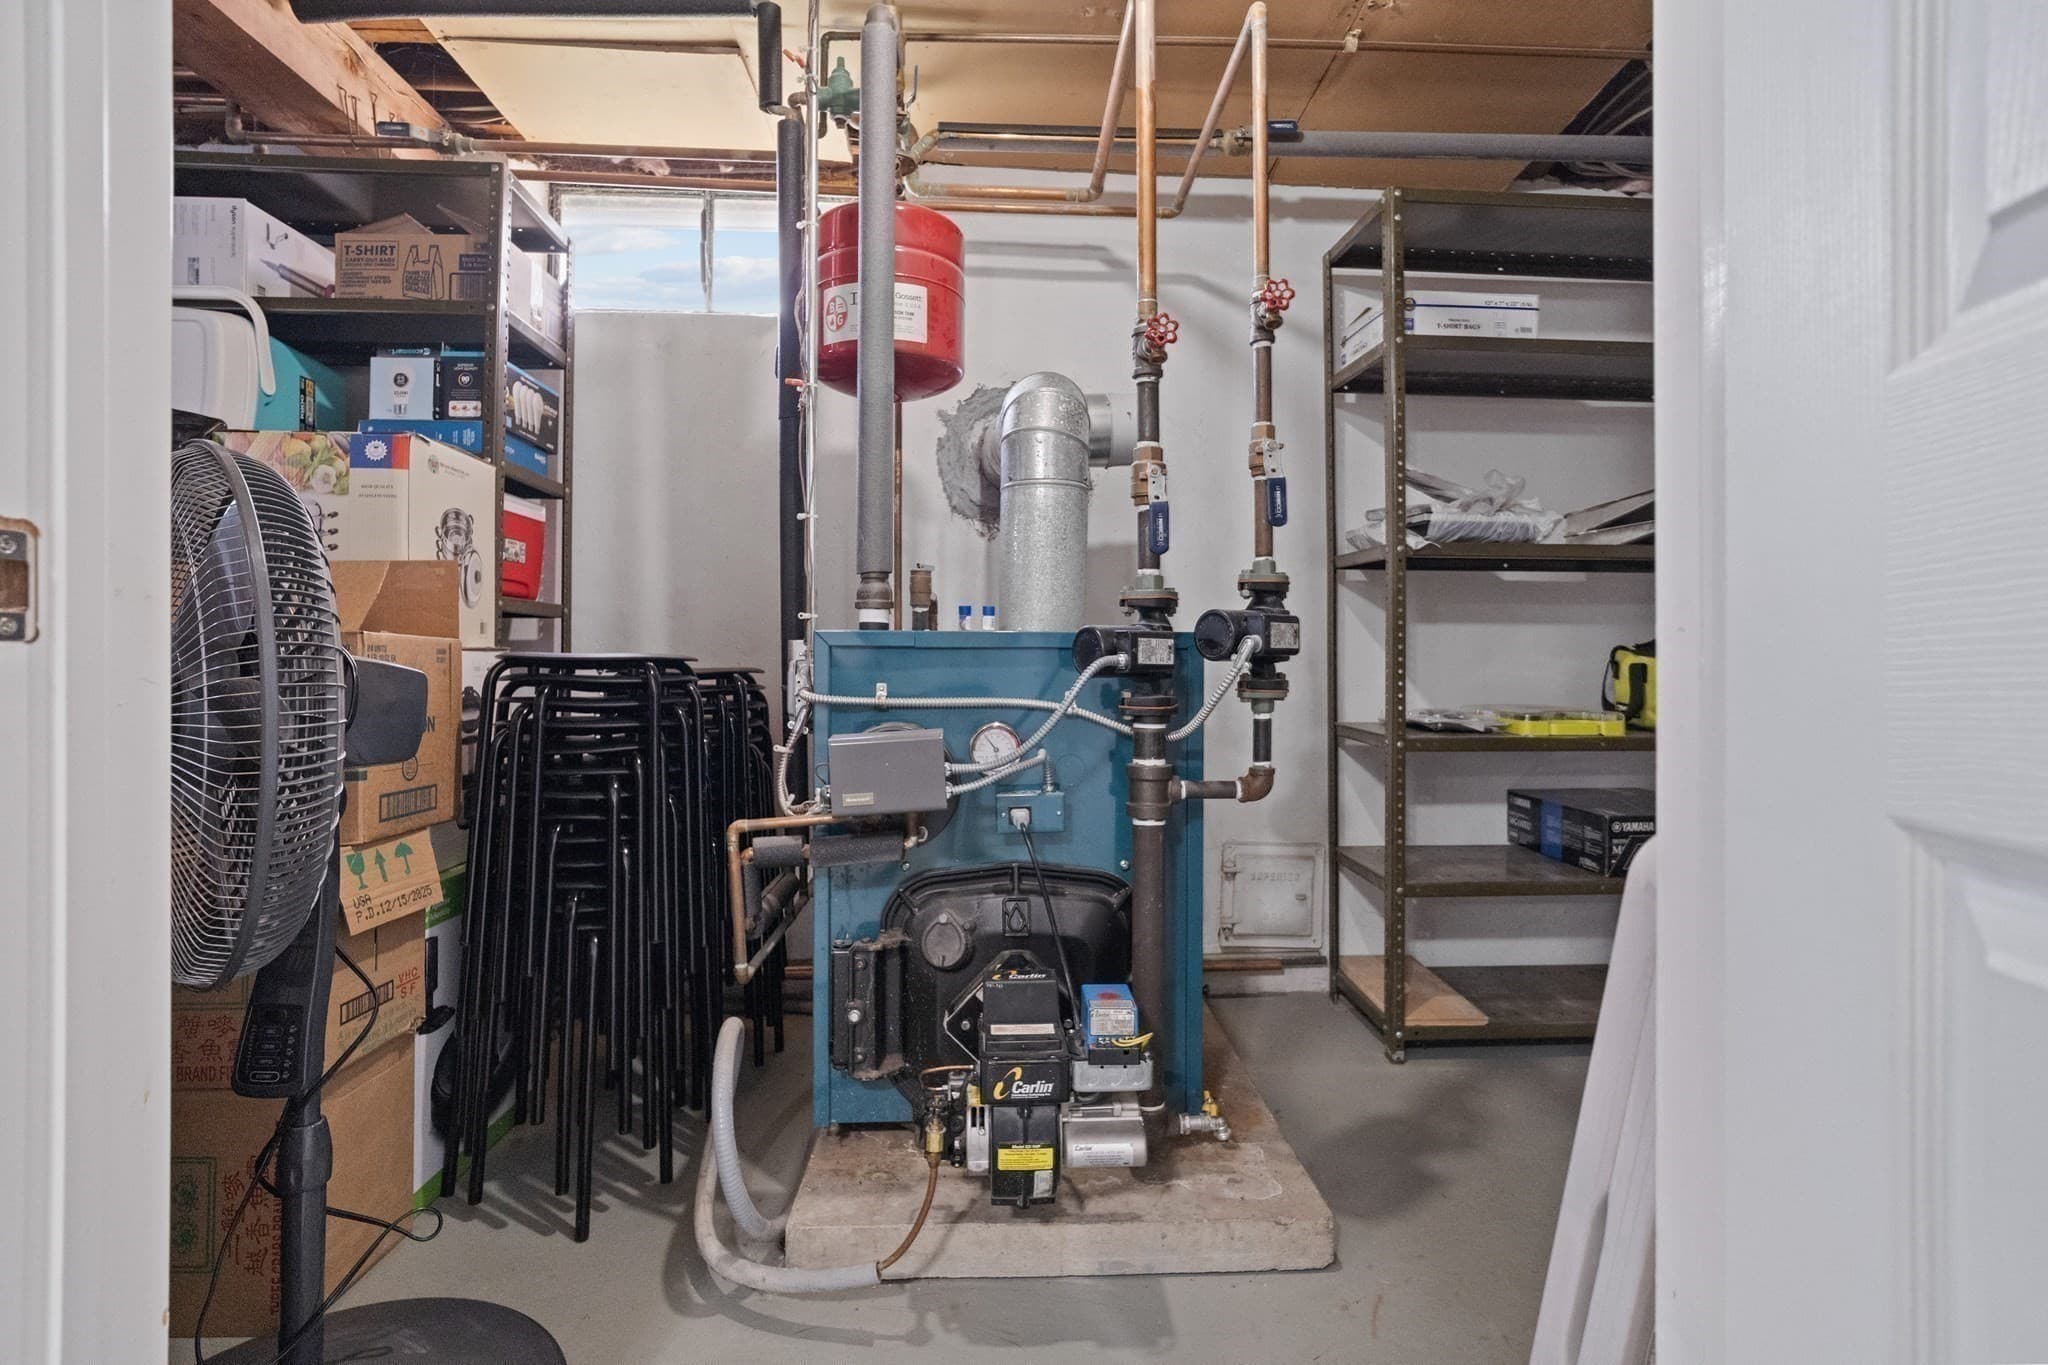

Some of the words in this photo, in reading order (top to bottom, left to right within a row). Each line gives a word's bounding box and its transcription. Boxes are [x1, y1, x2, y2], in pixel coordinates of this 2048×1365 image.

[344, 245, 396, 256] T-SHIRT
[895, 292, 922, 303] Gossett
[1622, 821, 1654, 832] YAMAHA
[352, 894, 372, 909] USA
[398, 967, 419, 984] VHC
[176, 1065, 216, 1082] BRAND
[1011, 1080, 1054, 1094] Carlin
